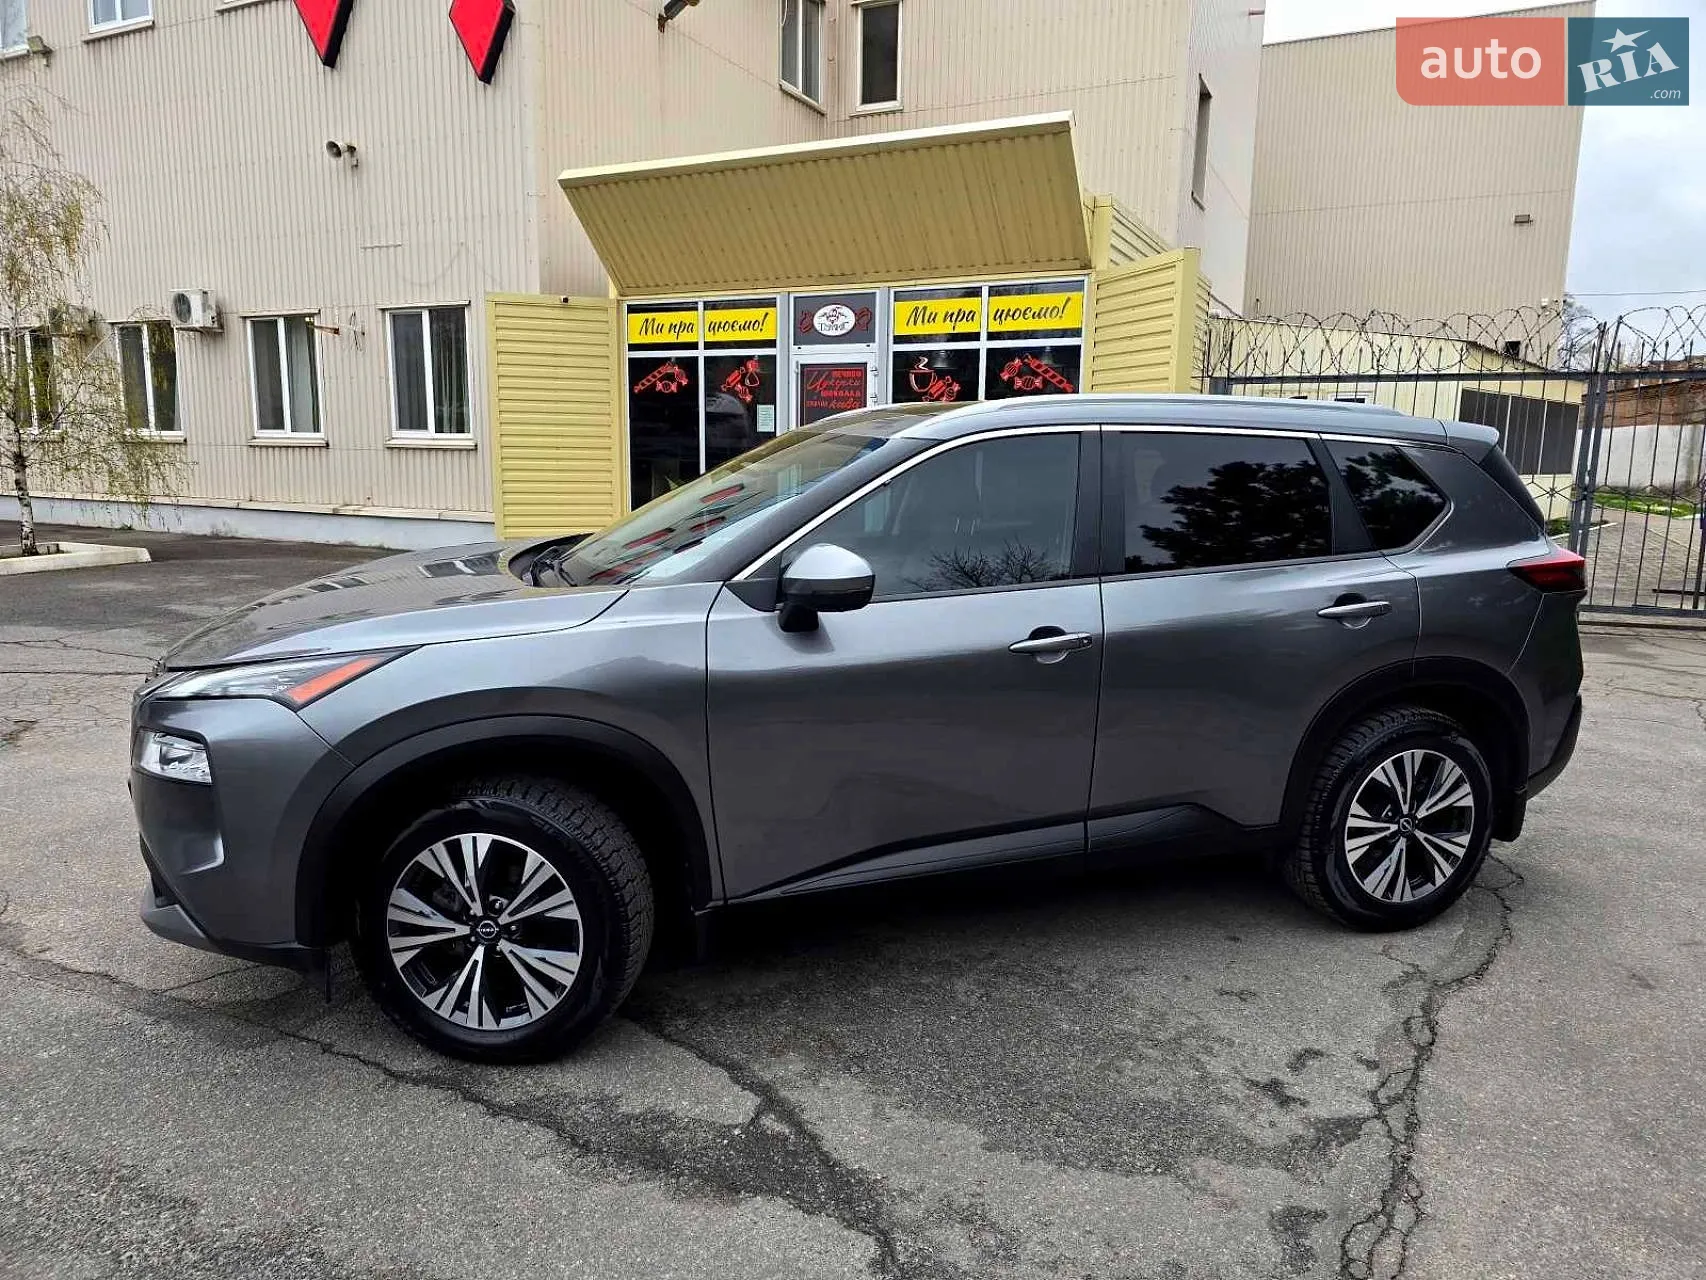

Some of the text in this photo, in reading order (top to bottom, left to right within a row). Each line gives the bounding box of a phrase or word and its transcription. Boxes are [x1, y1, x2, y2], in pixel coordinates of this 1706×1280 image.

[638, 317, 664, 336] Ми
[707, 312, 769, 334] цюємо!
[906, 306, 938, 327] Ми
[993, 297, 1071, 325] цюємо!
